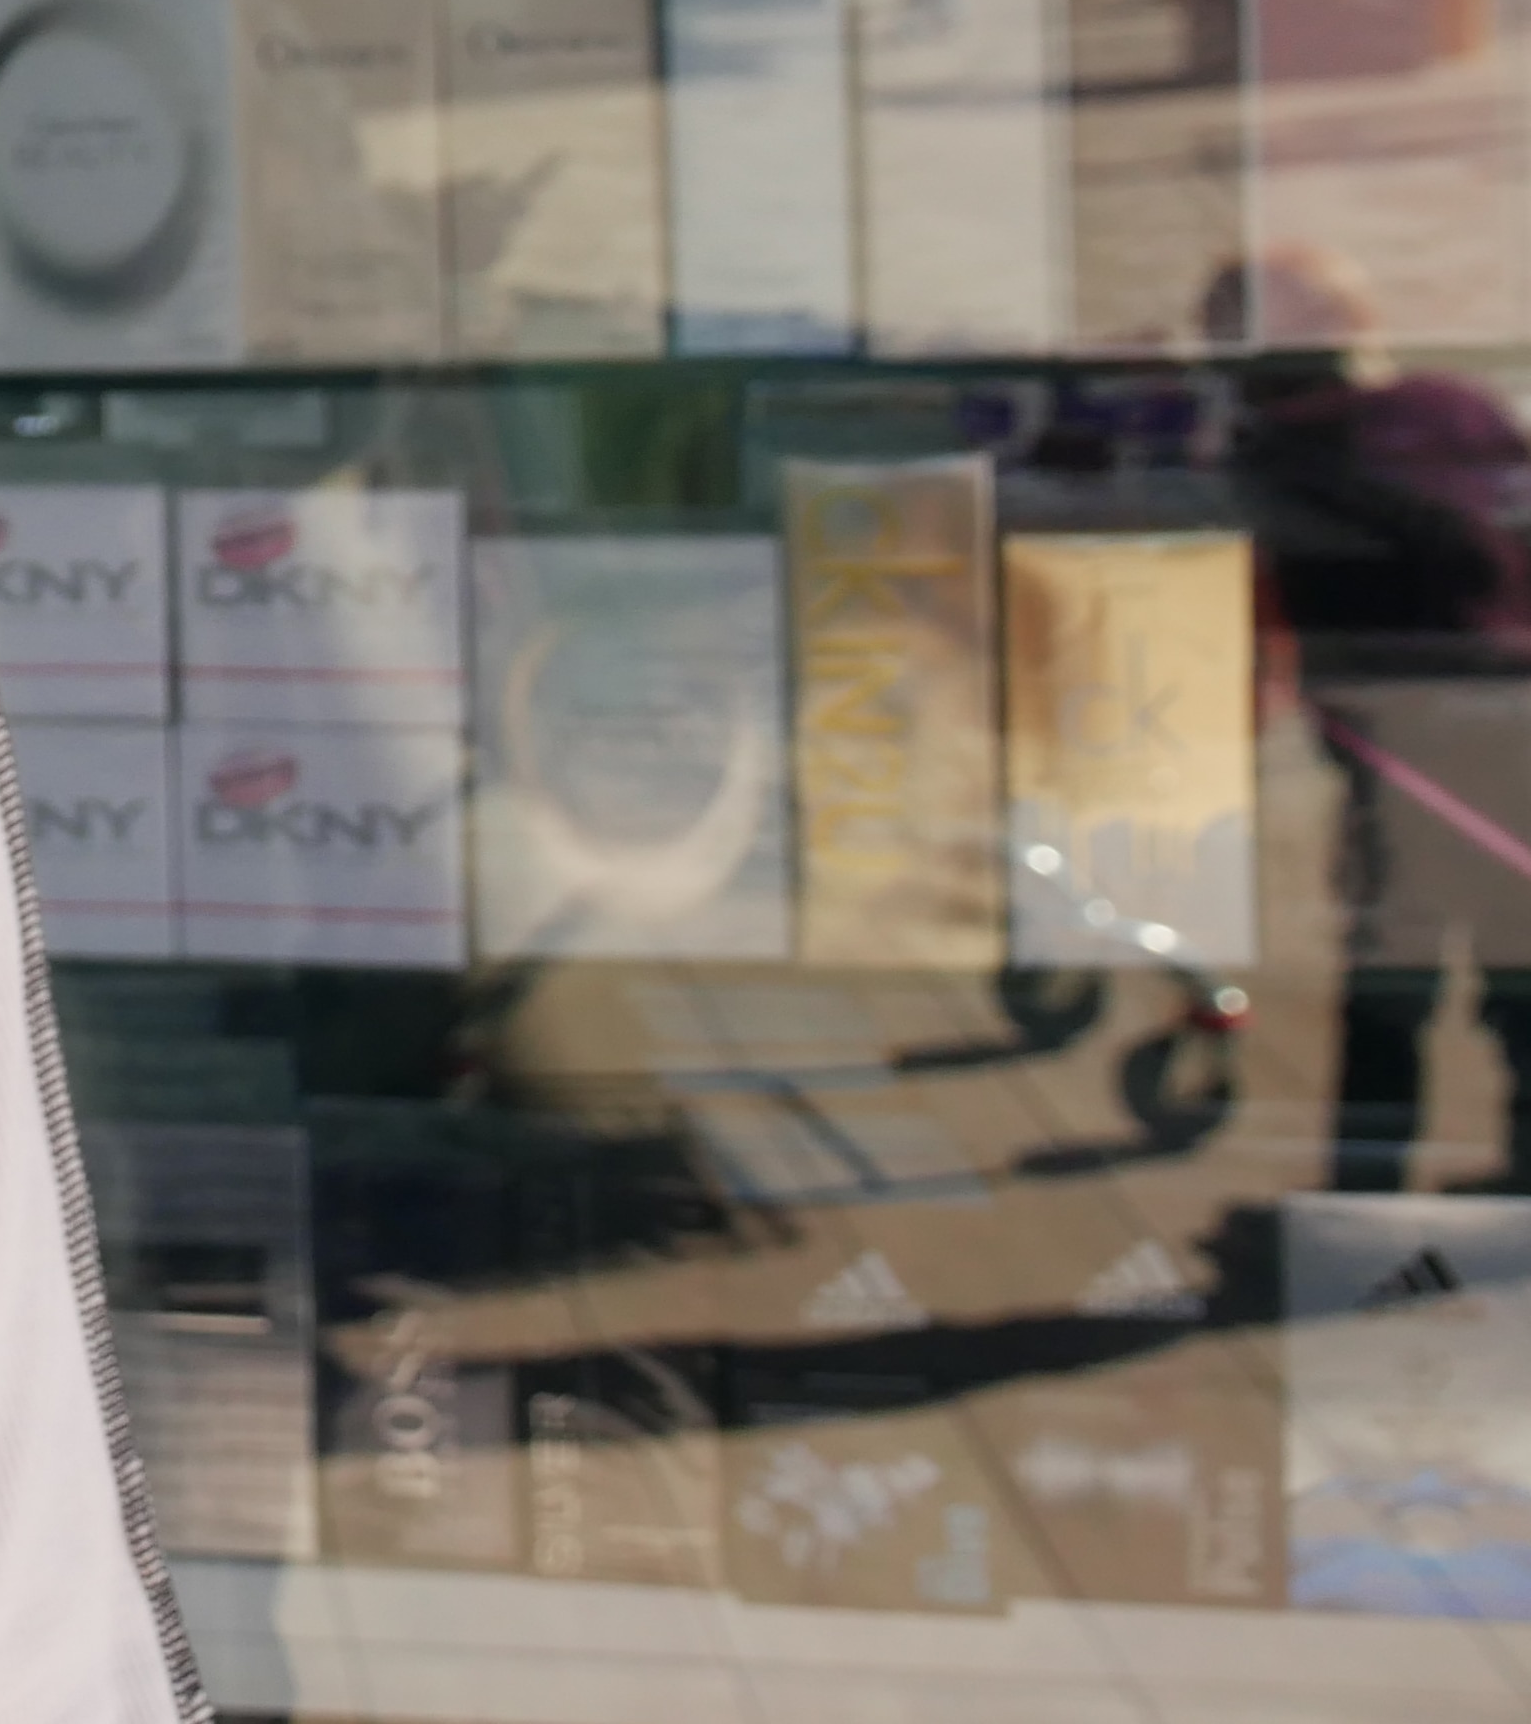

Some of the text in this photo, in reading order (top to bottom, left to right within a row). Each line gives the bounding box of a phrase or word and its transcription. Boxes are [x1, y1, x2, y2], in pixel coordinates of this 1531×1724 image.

[198, 562, 437, 609] DKNY
[26, 796, 149, 842] NY
[196, 798, 444, 847] DKNY
